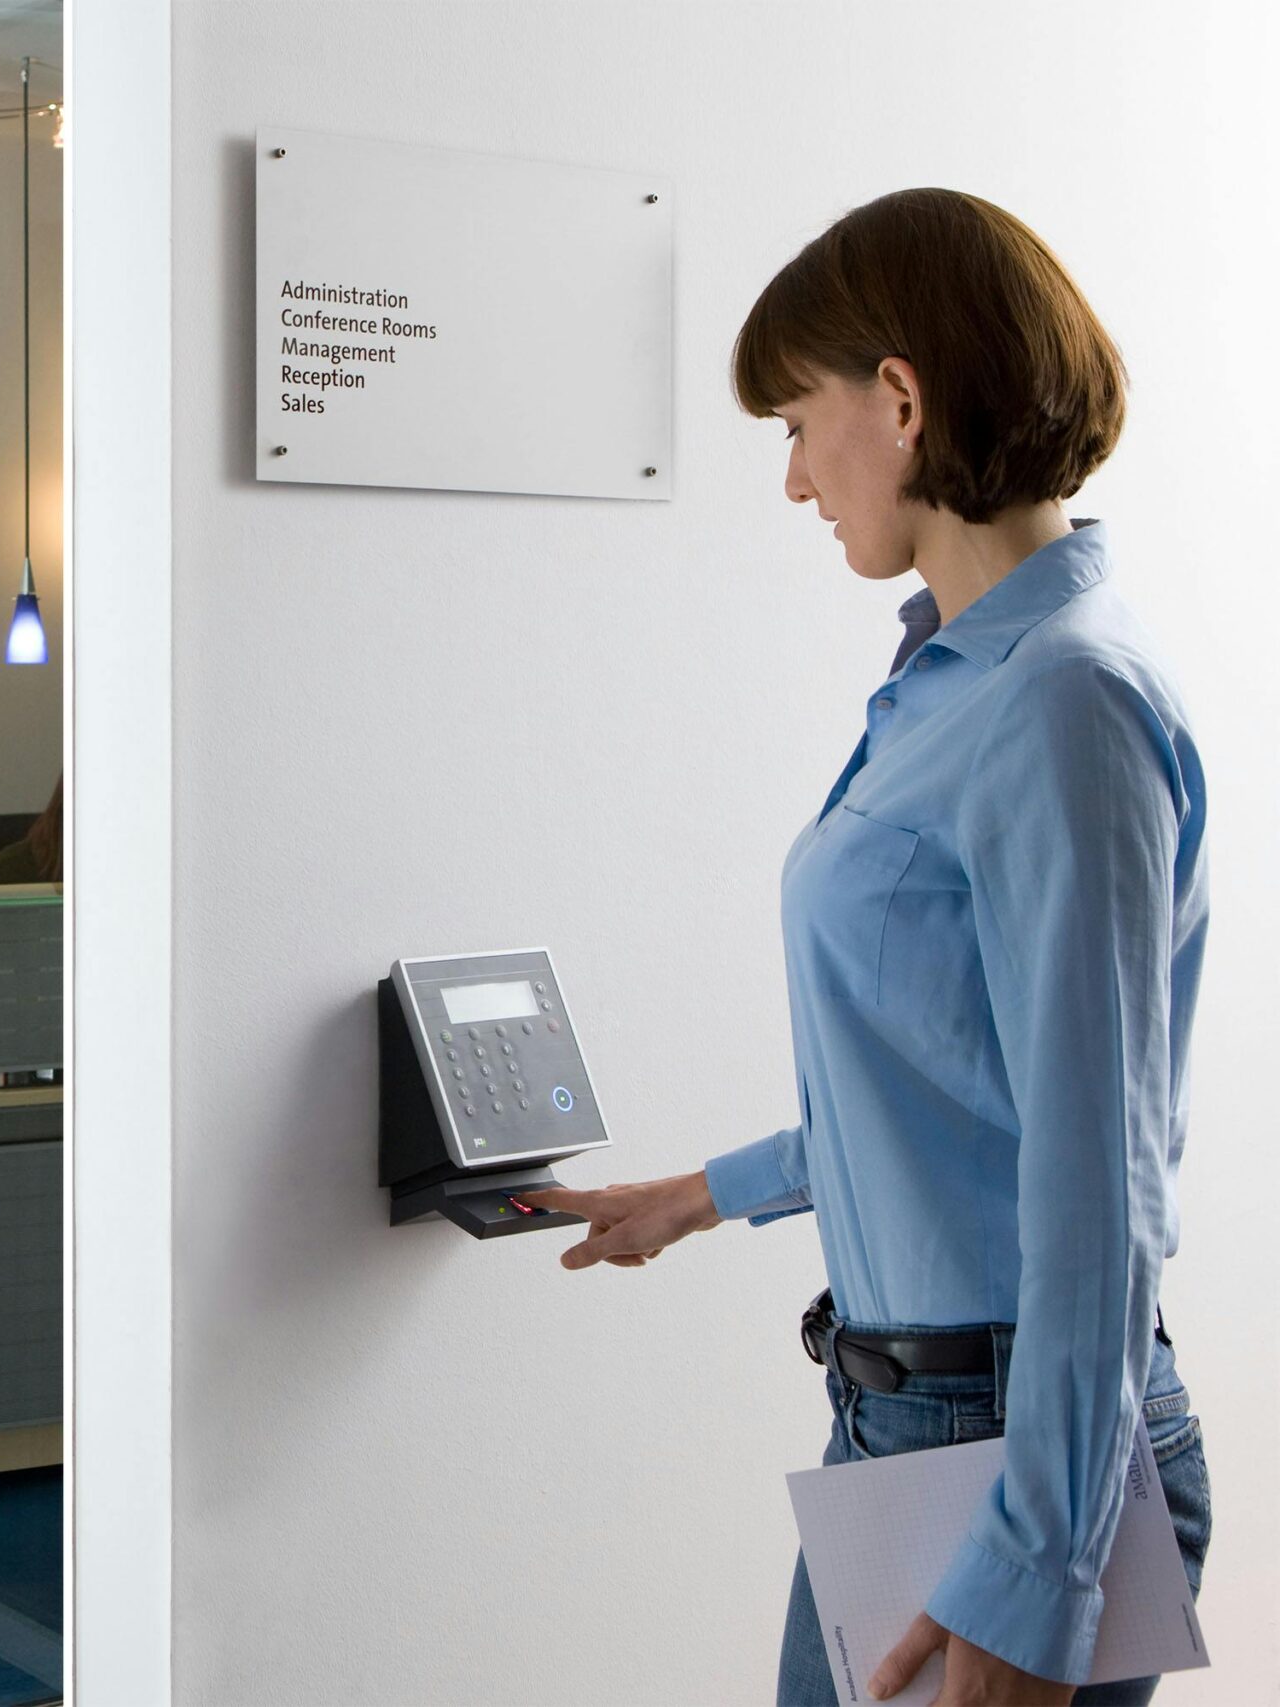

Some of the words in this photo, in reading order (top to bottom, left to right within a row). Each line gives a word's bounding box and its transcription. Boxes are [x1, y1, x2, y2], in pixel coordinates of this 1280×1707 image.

[281, 280, 408, 309] Administration
[281, 308, 377, 334] Conference
[382, 317, 437, 339] Rooms
[281, 337, 396, 365] Management
[281, 365, 365, 391] Reception
[281, 393, 325, 414] Sales
